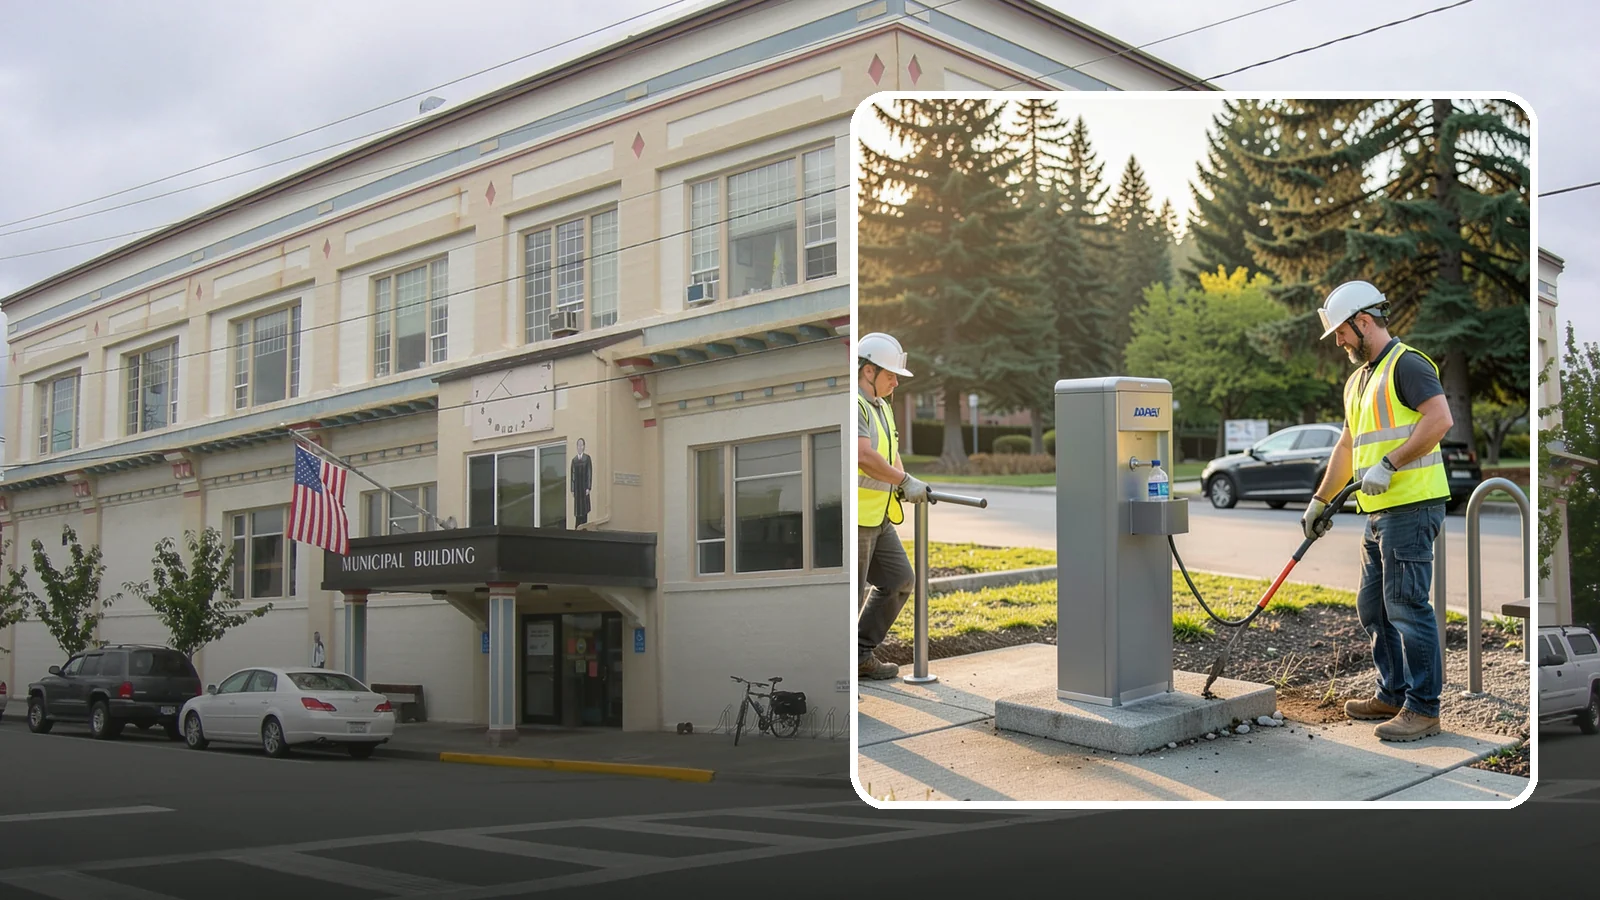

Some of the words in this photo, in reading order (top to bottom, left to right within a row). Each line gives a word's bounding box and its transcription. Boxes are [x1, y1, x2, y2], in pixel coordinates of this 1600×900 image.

[494, 424, 500, 432] 10
[342, 552, 405, 571] MUNICIPAL
[414, 546, 475, 566] BUILDING
